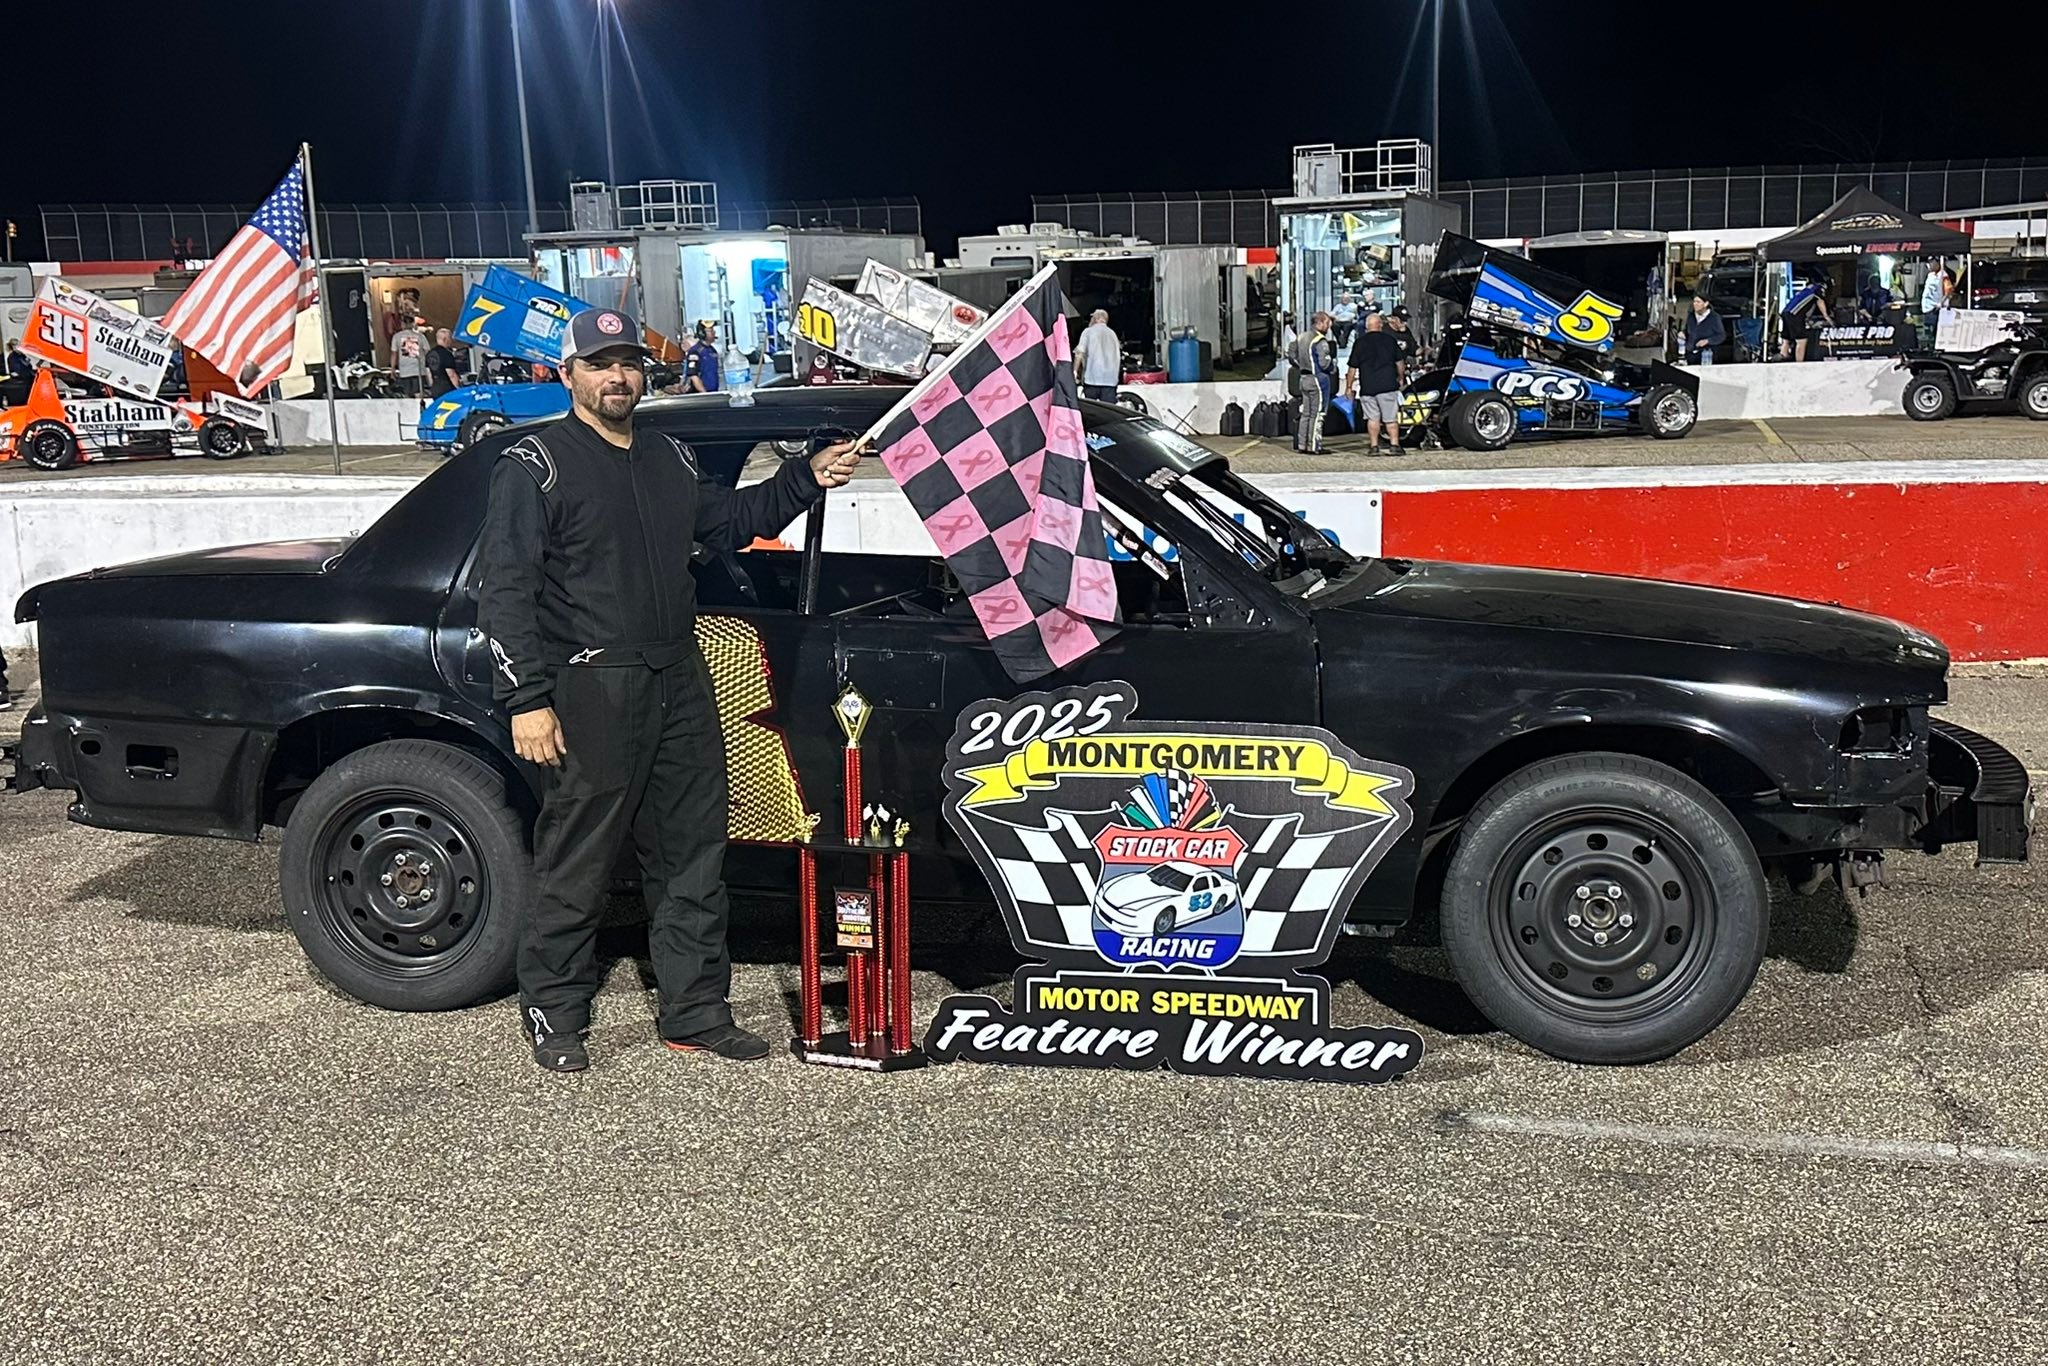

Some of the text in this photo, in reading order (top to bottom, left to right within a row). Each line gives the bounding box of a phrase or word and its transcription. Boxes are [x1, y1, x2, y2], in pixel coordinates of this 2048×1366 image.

[1816, 242, 1921, 256] Sponsored by ENGINE PRO
[39, 304, 85, 354] 36
[466, 295, 506, 337] 7
[1556, 291, 1624, 344] 5
[95, 326, 166, 368] Statham
[1820, 326, 1895, 340] ENGINE PRO
[1500, 371, 1581, 401] PCS
[64, 401, 166, 424] Statham
[434, 401, 462, 429] 7
[960, 693, 1124, 755] 2025
[1046, 741, 1306, 772] MONTGOMERY
[1108, 835, 1230, 860] STOCK CAR
[838, 923, 871, 934] WINNER
[1119, 936, 1217, 960] RACING
[1039, 987, 1305, 1021] MOTOR SPEEDWAY
[936, 1008, 1410, 1073] Feature Winner
